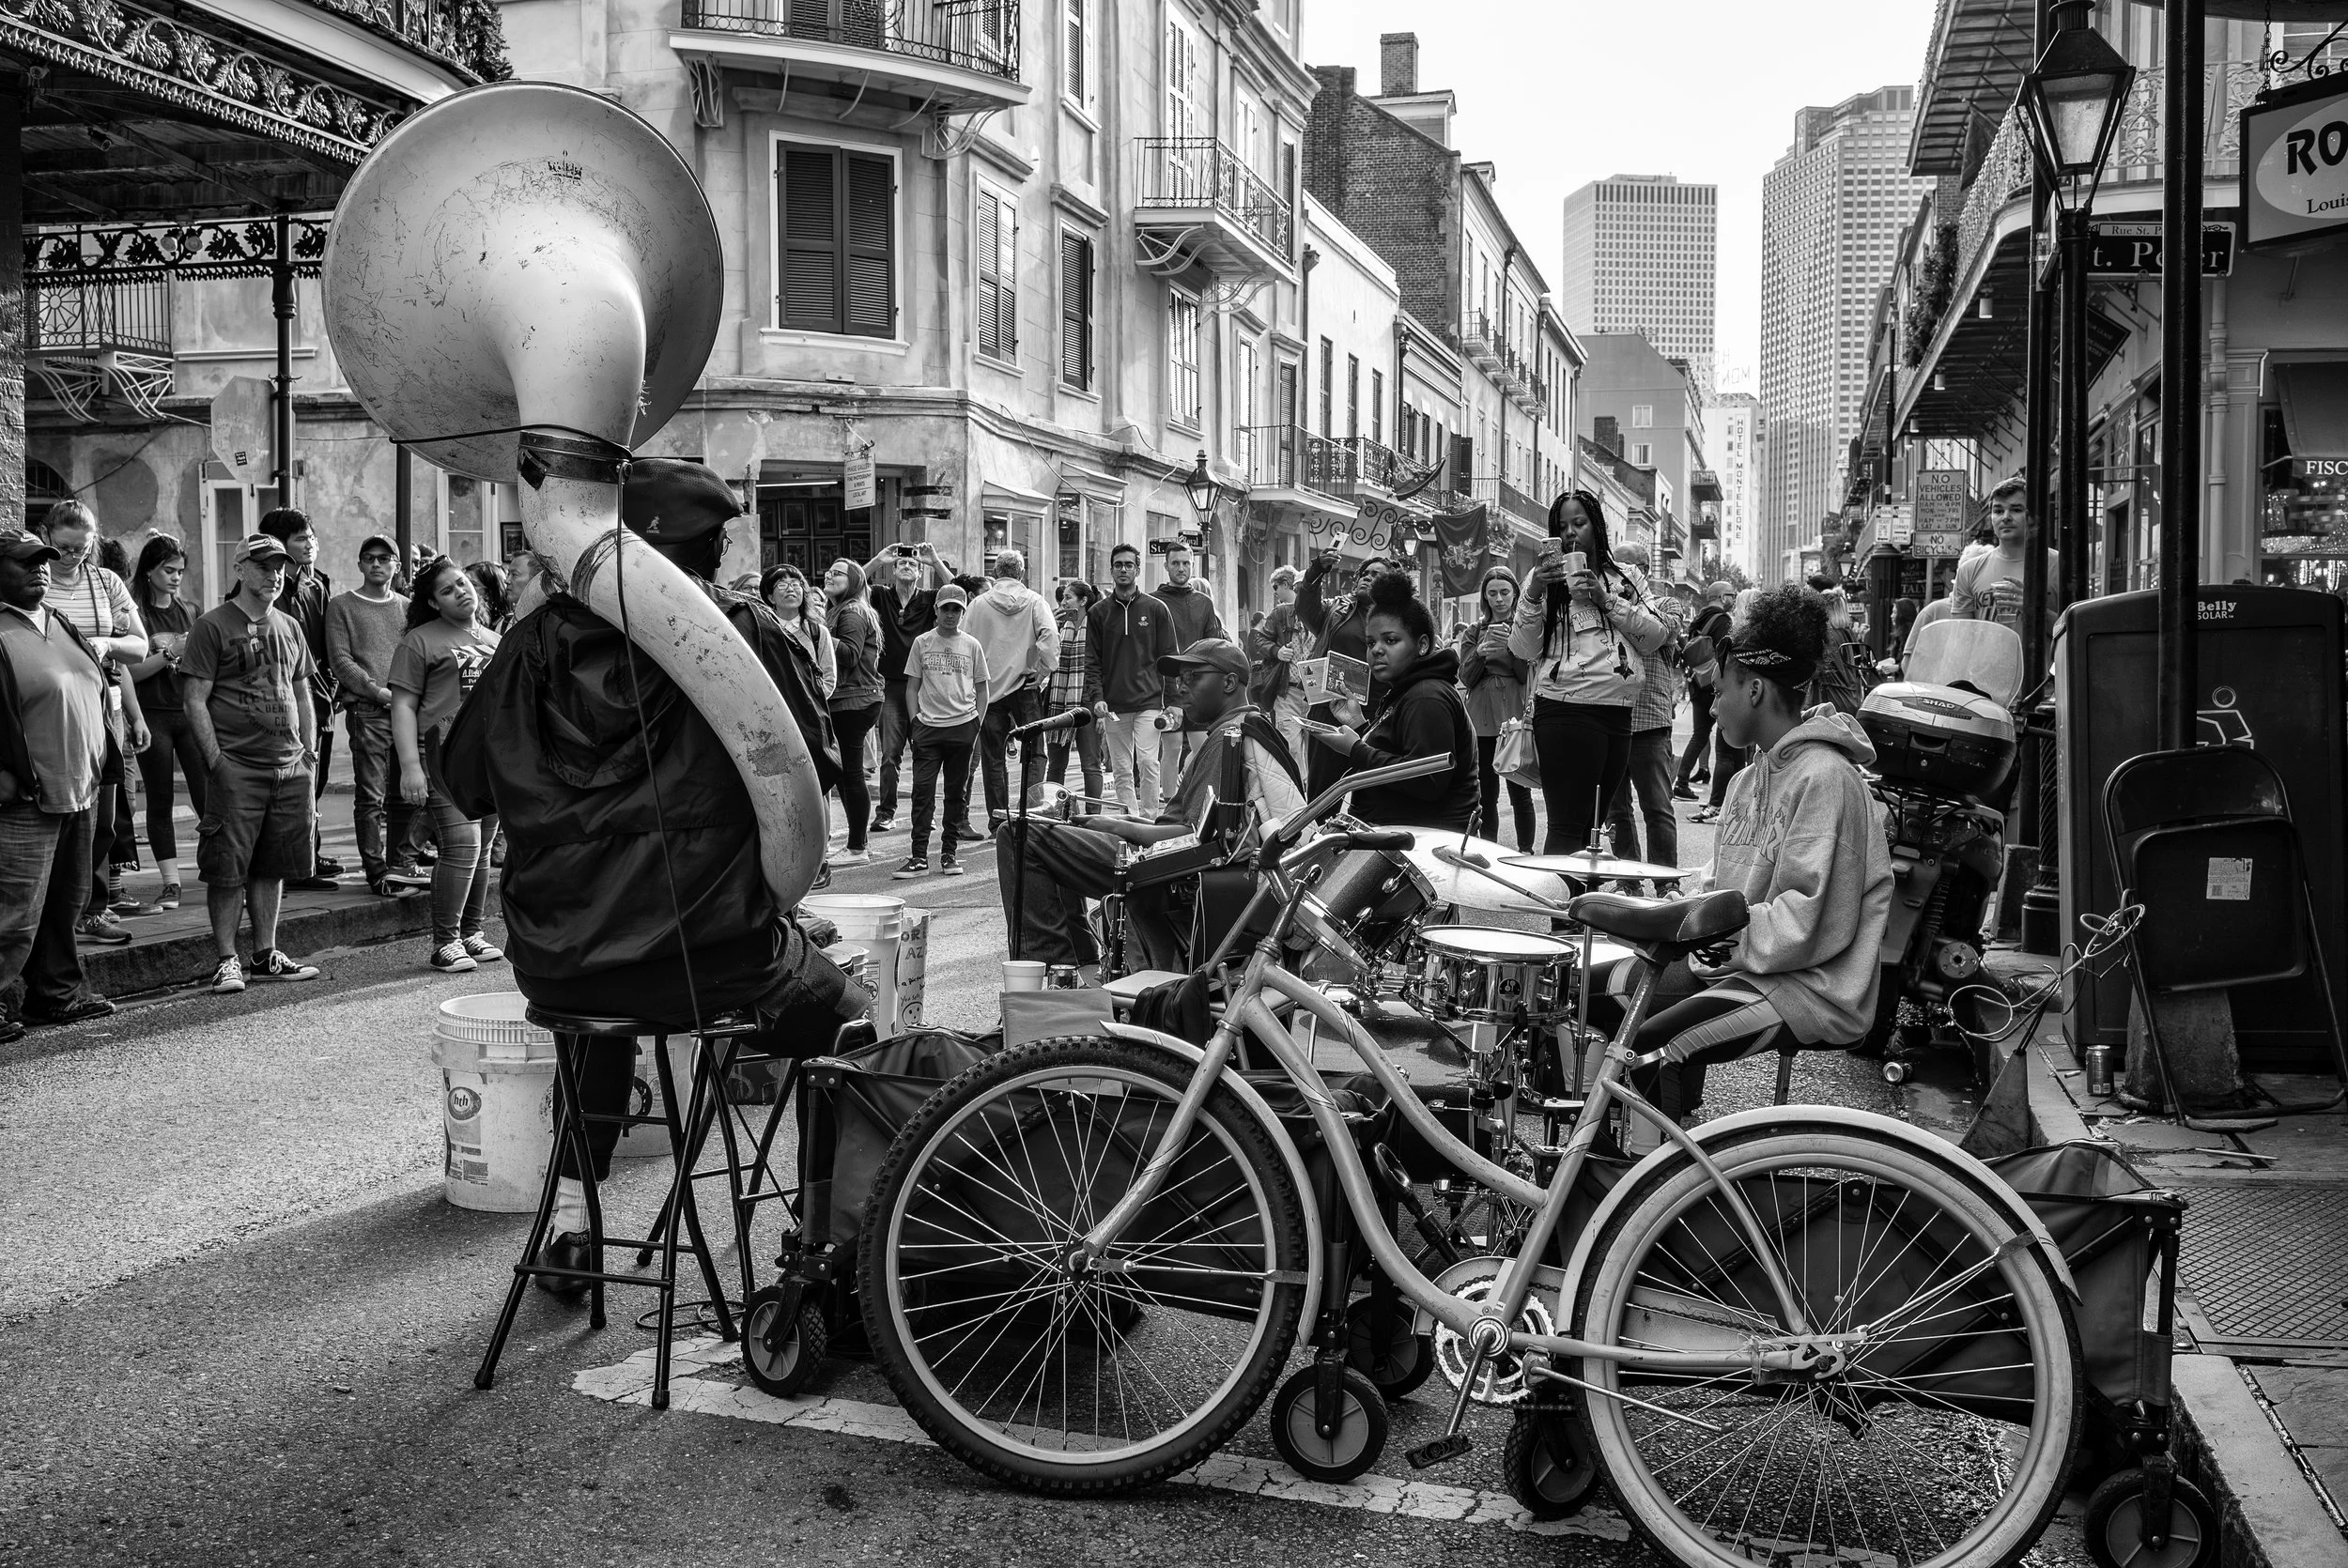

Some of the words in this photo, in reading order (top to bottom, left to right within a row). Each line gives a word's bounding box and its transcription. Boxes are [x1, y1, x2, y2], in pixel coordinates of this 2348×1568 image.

[2286, 120, 2348, 176] RO
[2111, 225, 2132, 235] Rue
[2136, 225, 2150, 235] St.
[2093, 246, 2112, 267] t.
[1932, 474, 1951, 484] NO
[1920, 484, 1962, 493] VEHICLES
[1919, 493, 1961, 501] ALLOWED
[1930, 535, 1944, 545] NO
[1151, 544, 1165, 553] St.
[924, 656, 970, 669] CHAMPIONS
[1923, 698, 1954, 709] SHAD
[454, 1094, 469, 1107] hth
